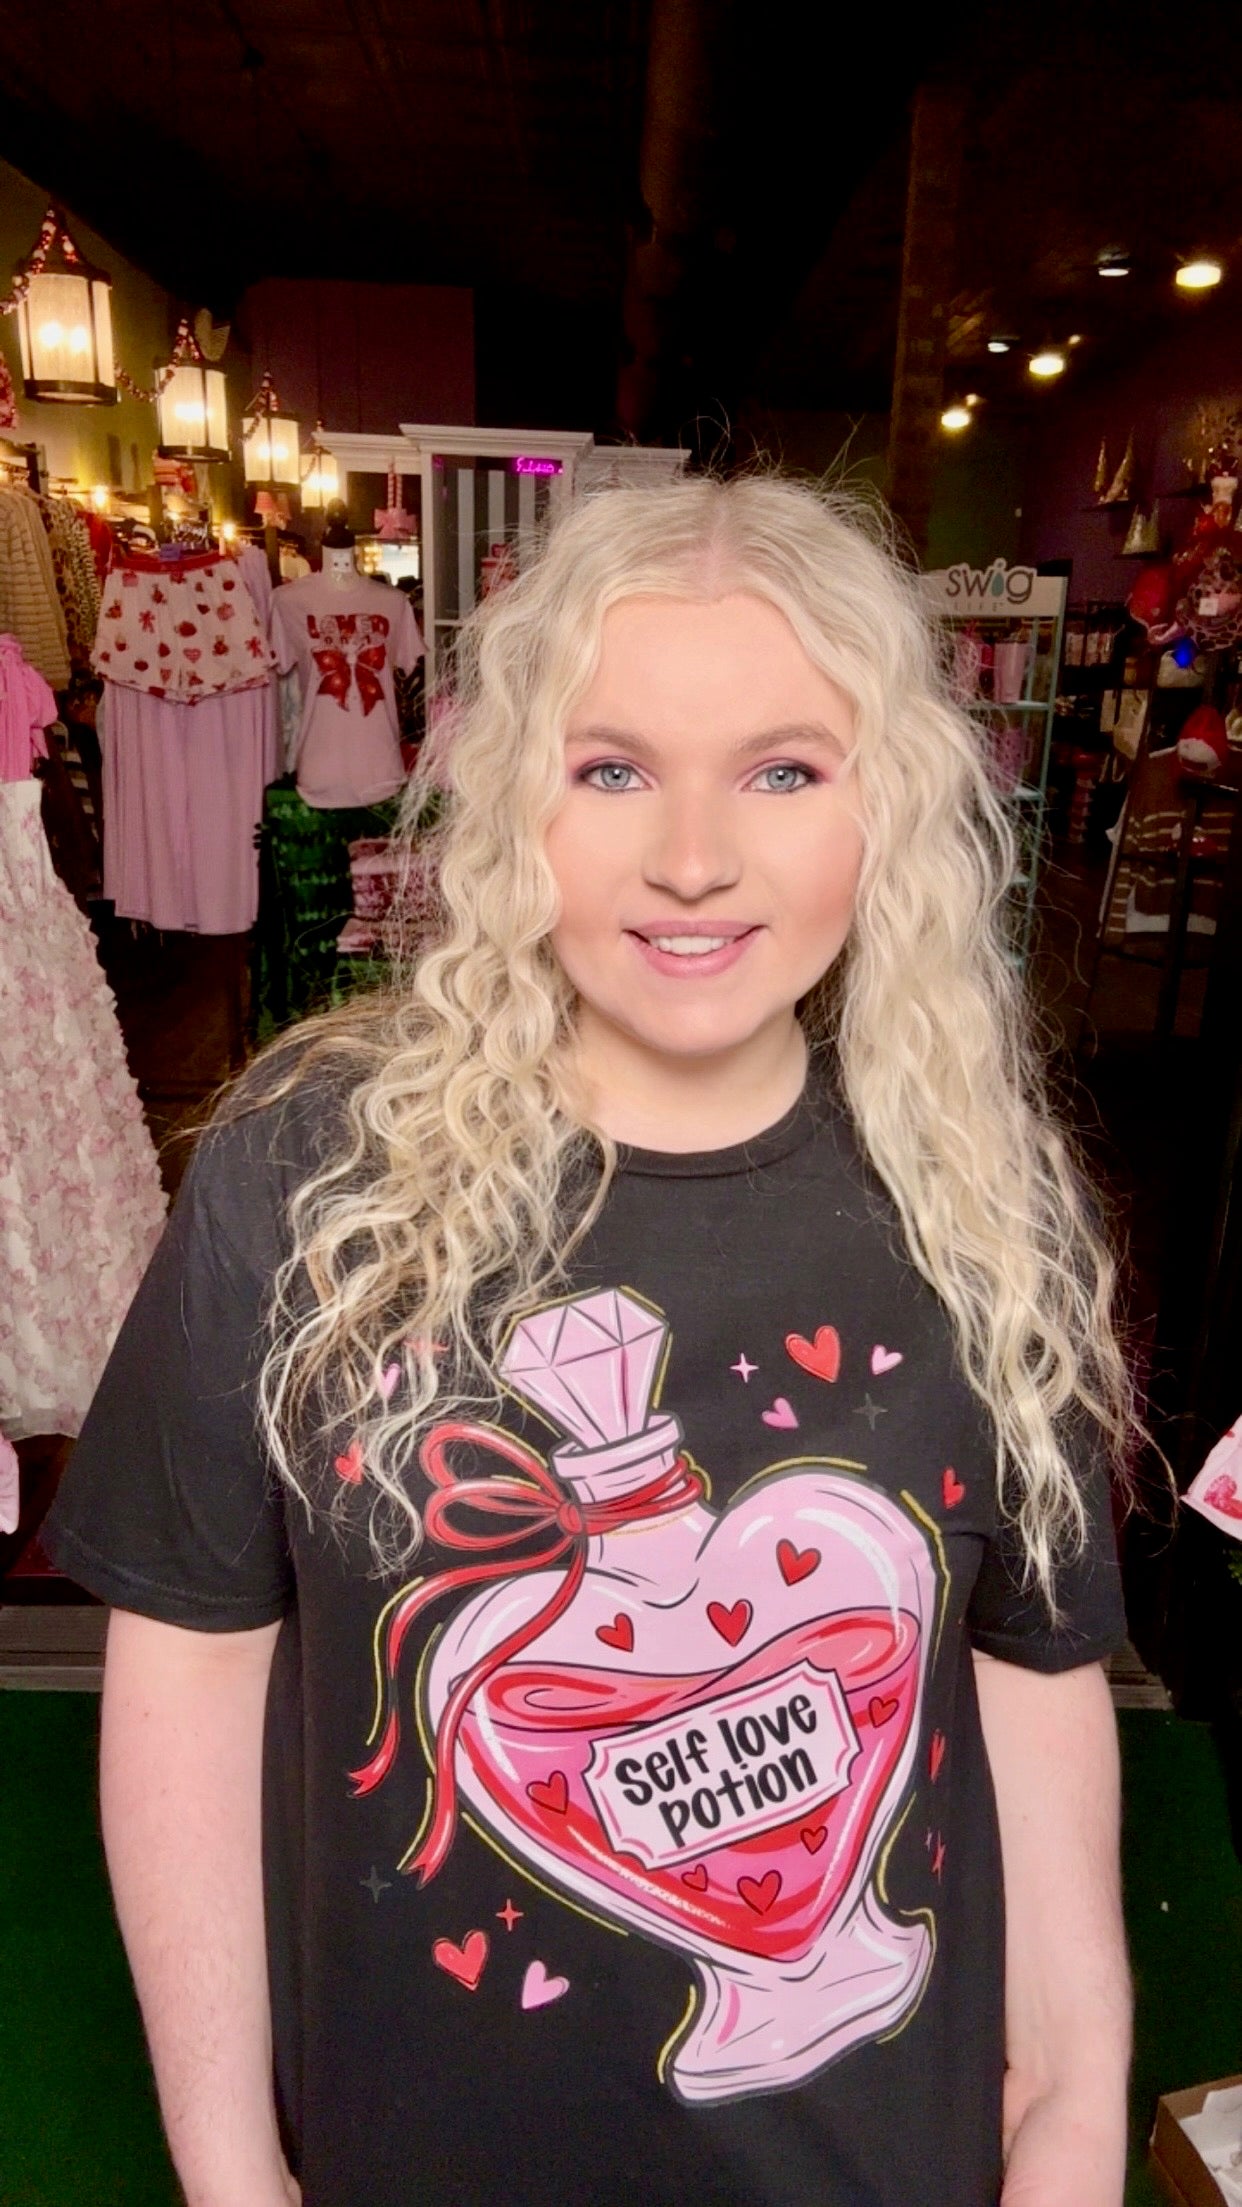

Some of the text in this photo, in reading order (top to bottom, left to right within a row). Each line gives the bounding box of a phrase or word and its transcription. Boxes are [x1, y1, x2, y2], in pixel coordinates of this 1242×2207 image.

[614, 1694, 817, 1806] self love
[658, 1747, 818, 1848] potion
